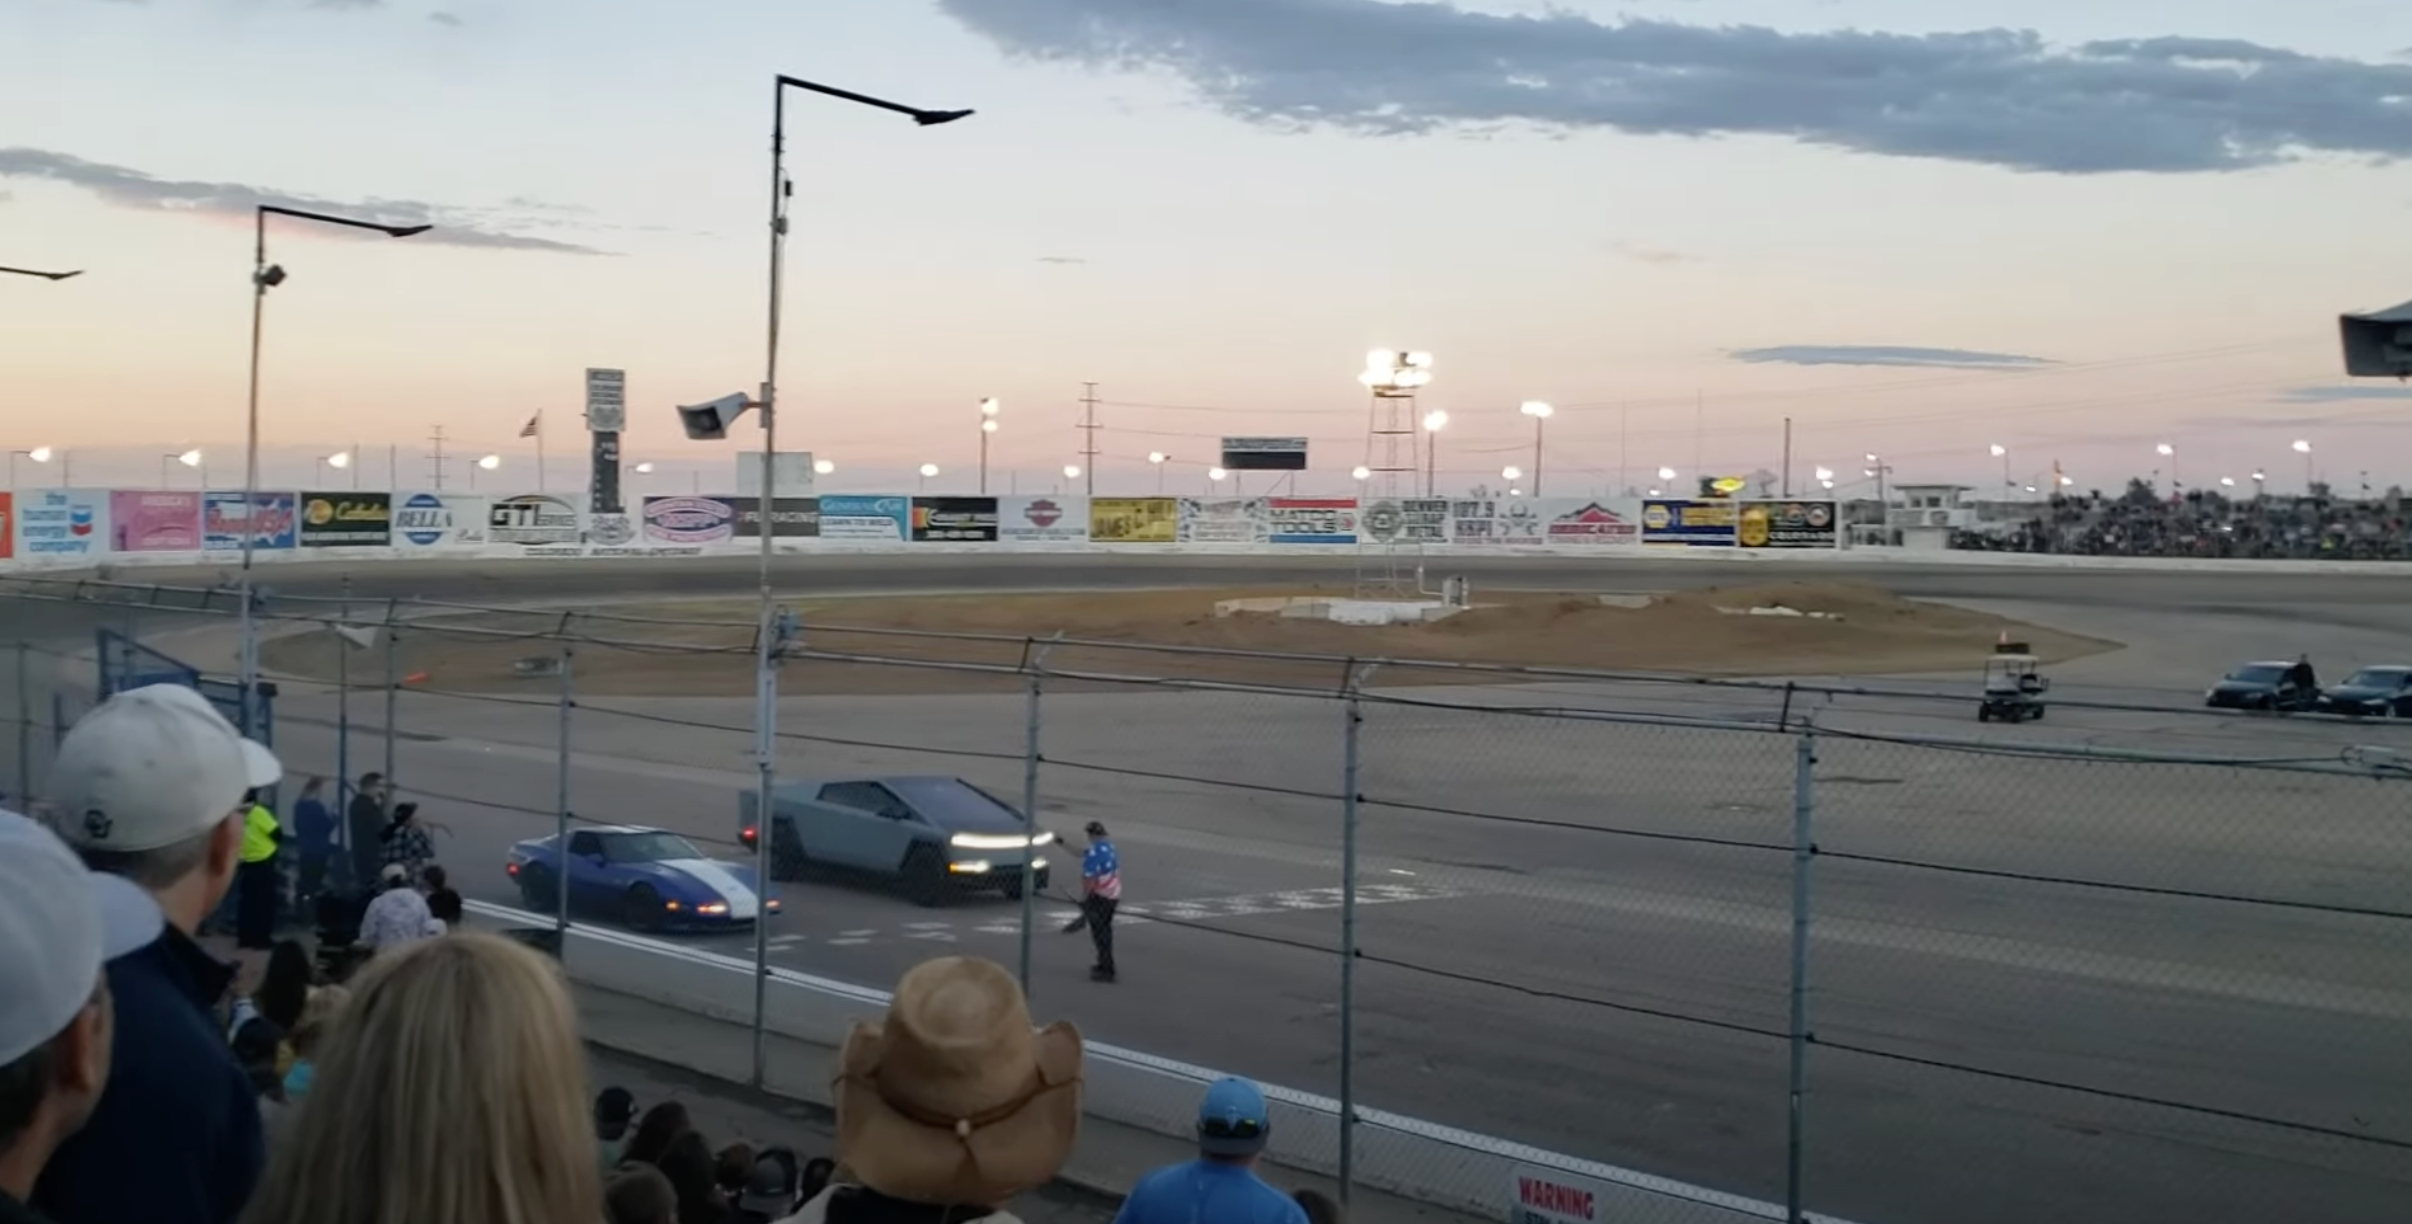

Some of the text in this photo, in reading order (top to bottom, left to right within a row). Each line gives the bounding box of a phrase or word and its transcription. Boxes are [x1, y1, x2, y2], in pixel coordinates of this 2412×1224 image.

[396, 510, 452, 528] BELLA
[1270, 522, 1336, 533] TOOLS
[30, 541, 90, 554] company
[1518, 1176, 1595, 1220] WARNING
